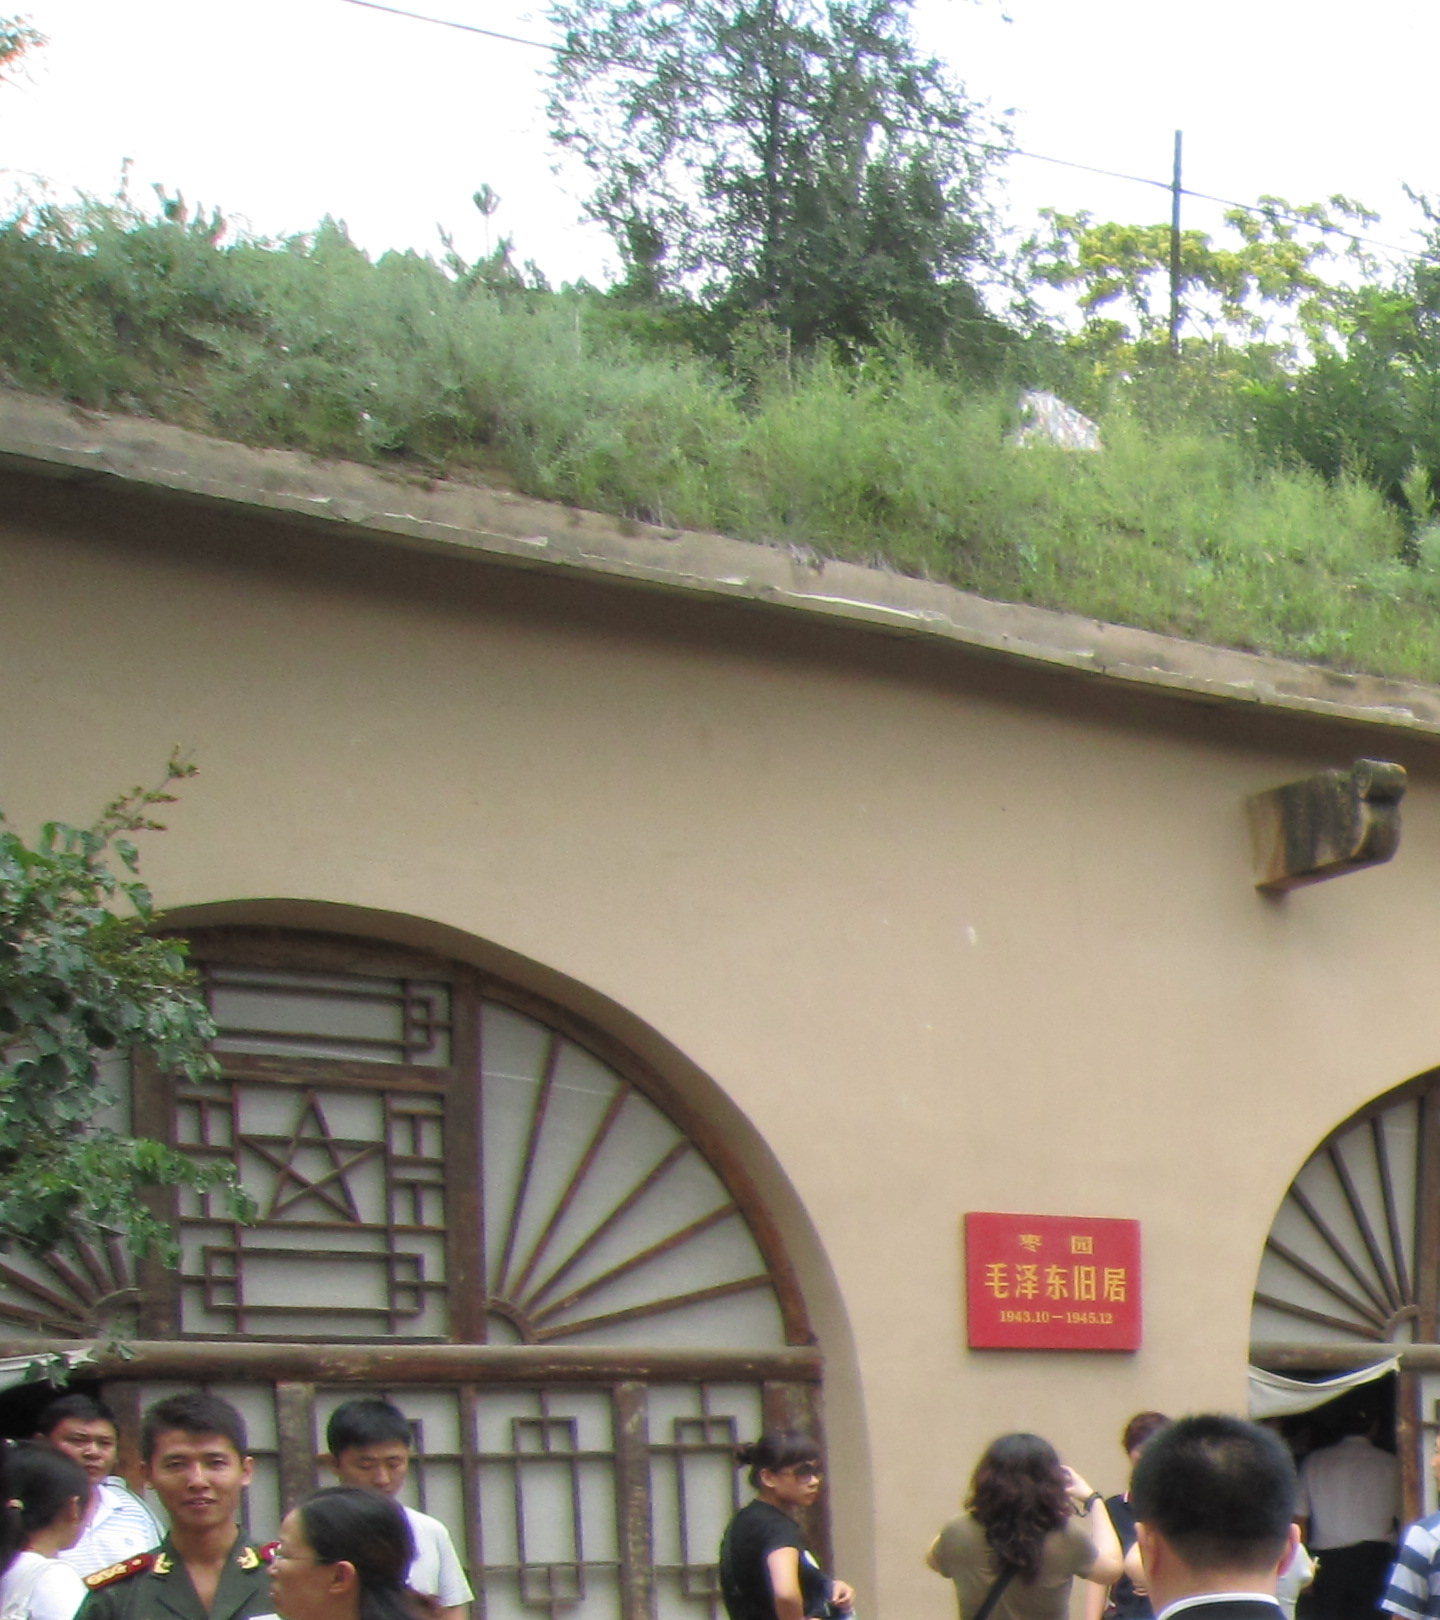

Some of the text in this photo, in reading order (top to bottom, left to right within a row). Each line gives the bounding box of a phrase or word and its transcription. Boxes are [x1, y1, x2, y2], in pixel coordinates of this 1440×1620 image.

[984, 1263, 1127, 1302] 毛泽东旧居
